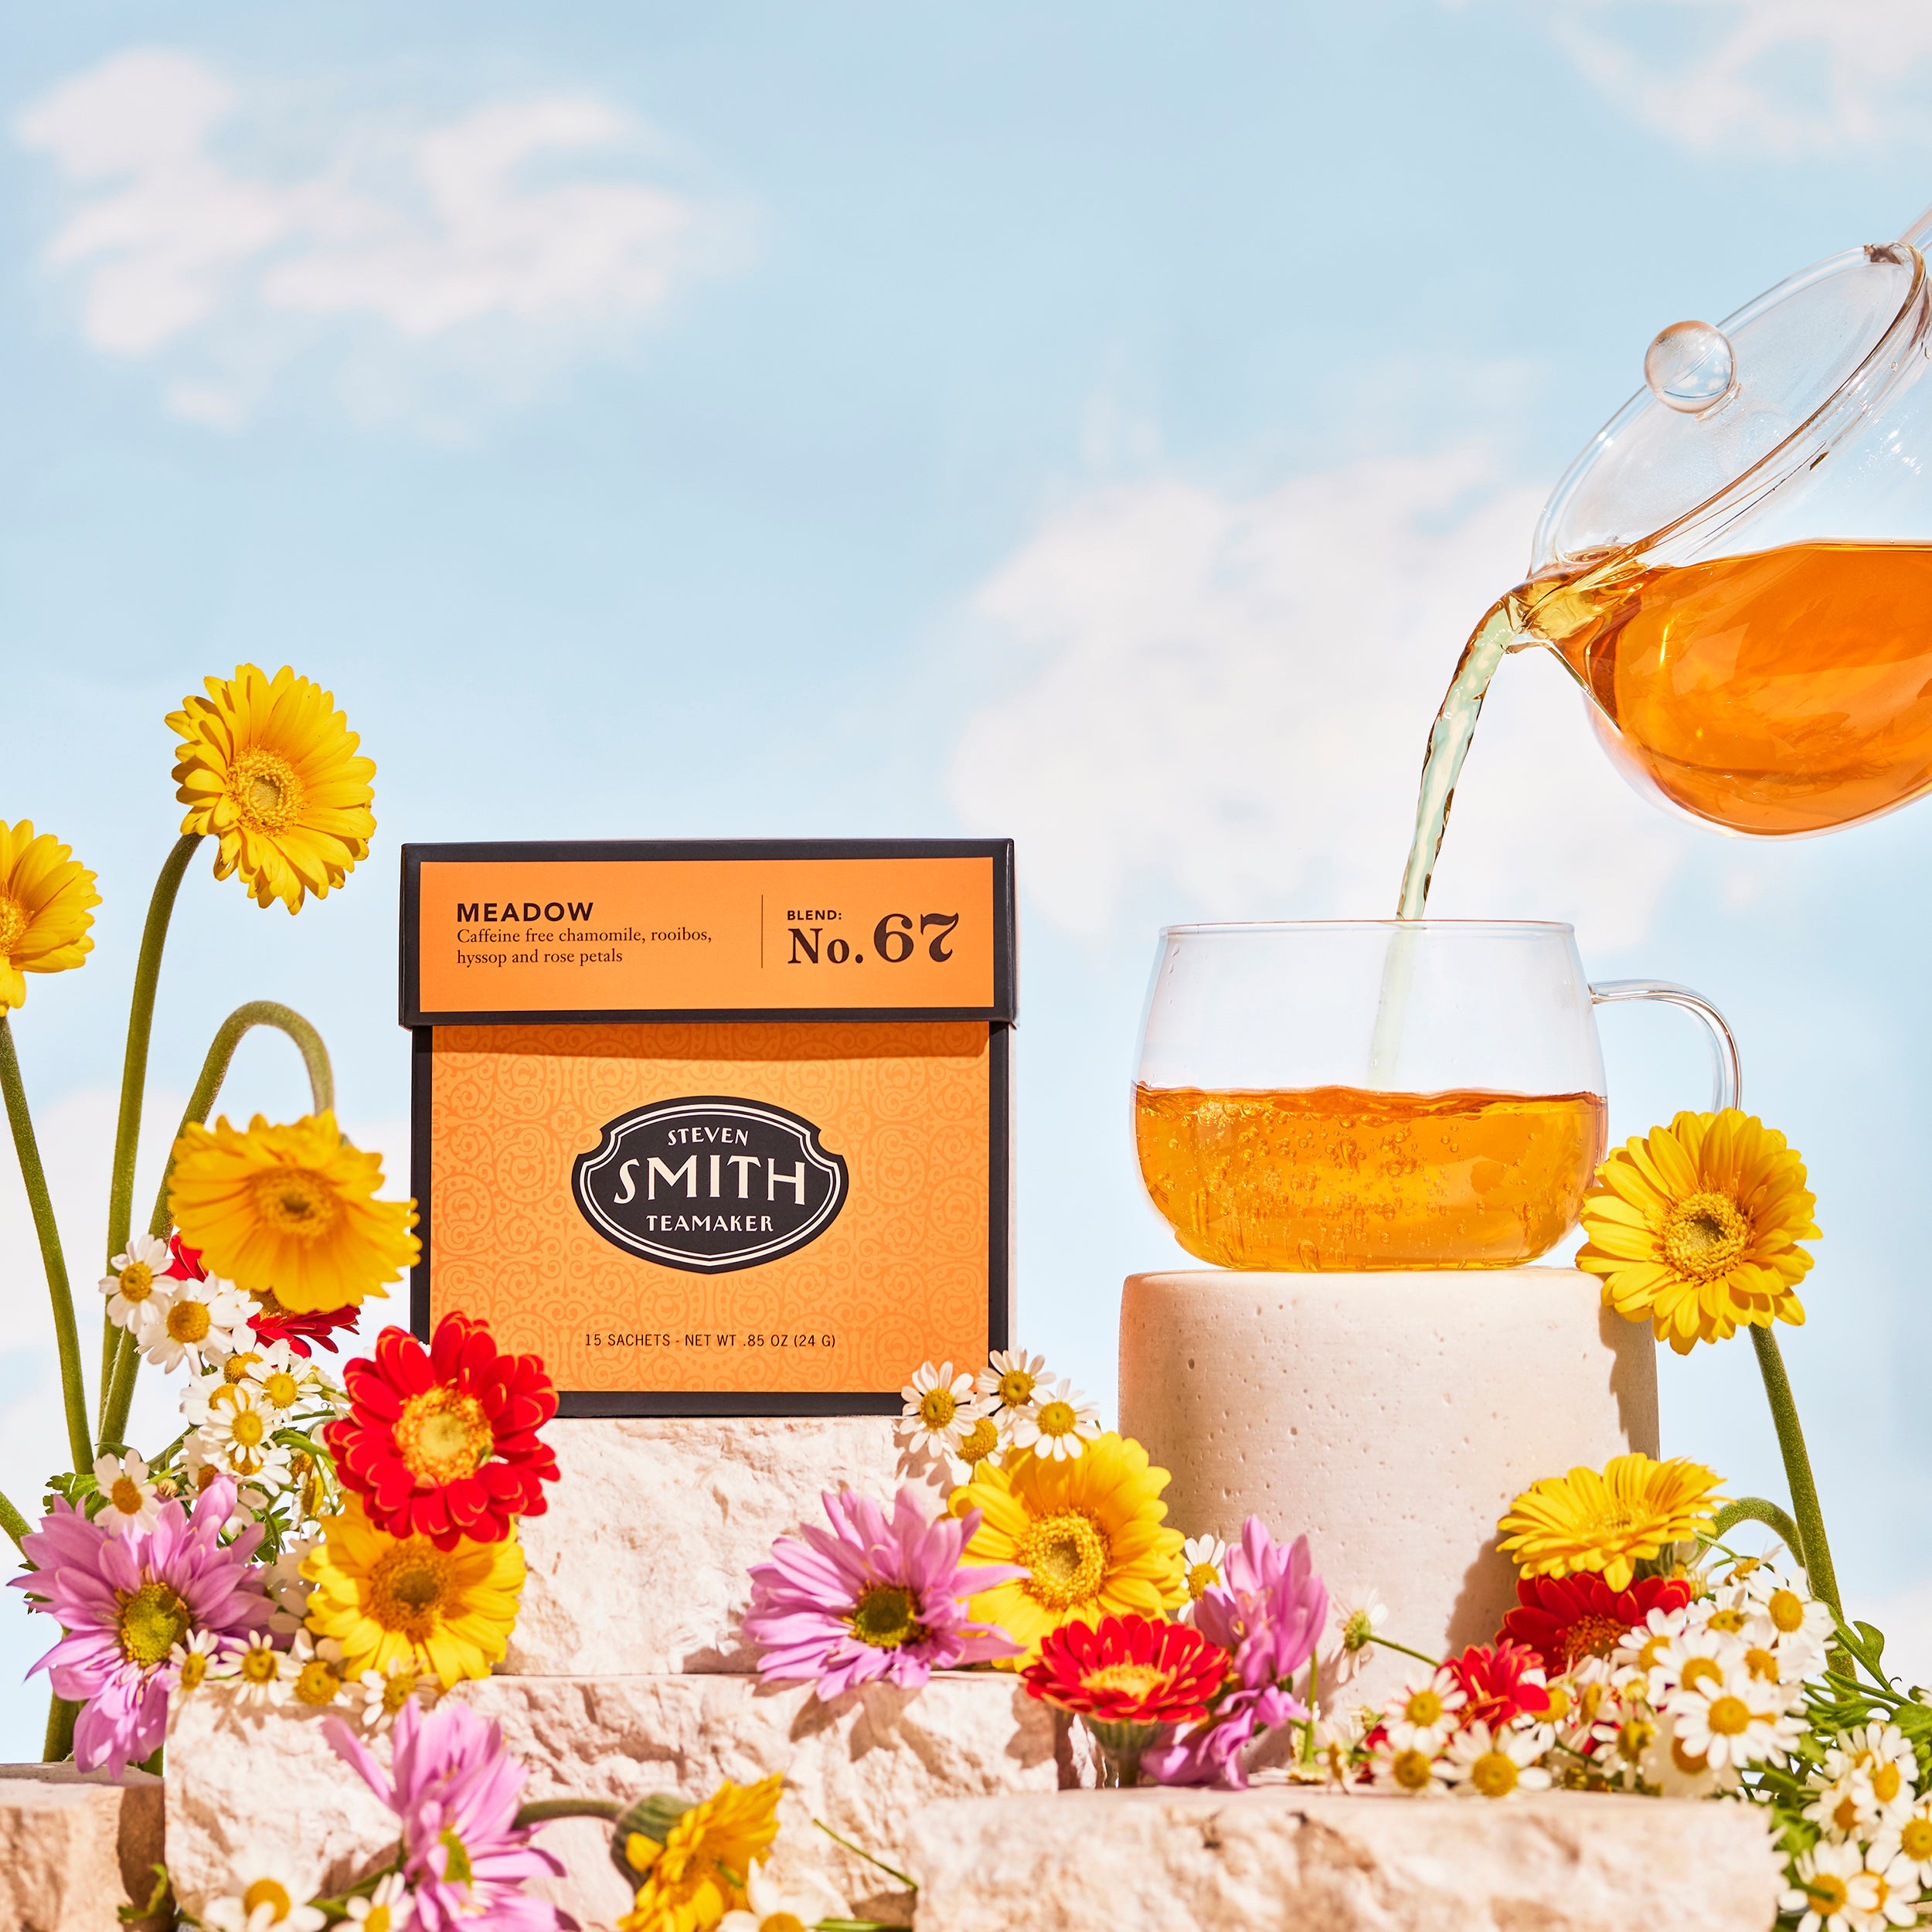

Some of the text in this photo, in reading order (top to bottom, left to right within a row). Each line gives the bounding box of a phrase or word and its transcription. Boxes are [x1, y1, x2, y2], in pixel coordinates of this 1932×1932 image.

[457, 902, 594, 923] MEADOW
[787, 910, 842, 921] BLEND:
[457, 927, 712, 944] Caffeine free chamomile, rooibos,
[787, 912, 960, 964] No. 67
[457, 947, 623, 968] hyssop and rose petals
[668, 1127, 749, 1147] STEVEN
[613, 1154, 806, 1206] SMITH
[645, 1215, 774, 1232] TEAMAKER
[586, 1333, 602, 1346] 15
[607, 1333, 671, 1346] SACHETS
[685, 1334, 712, 1346] NET
[716, 1334, 736, 1347] WT
[743, 1334, 764, 1347] .85
[770, 1334, 788, 1347] OZ
[794, 1334, 816, 1348] (24
[821, 1334, 835, 1349] G)
